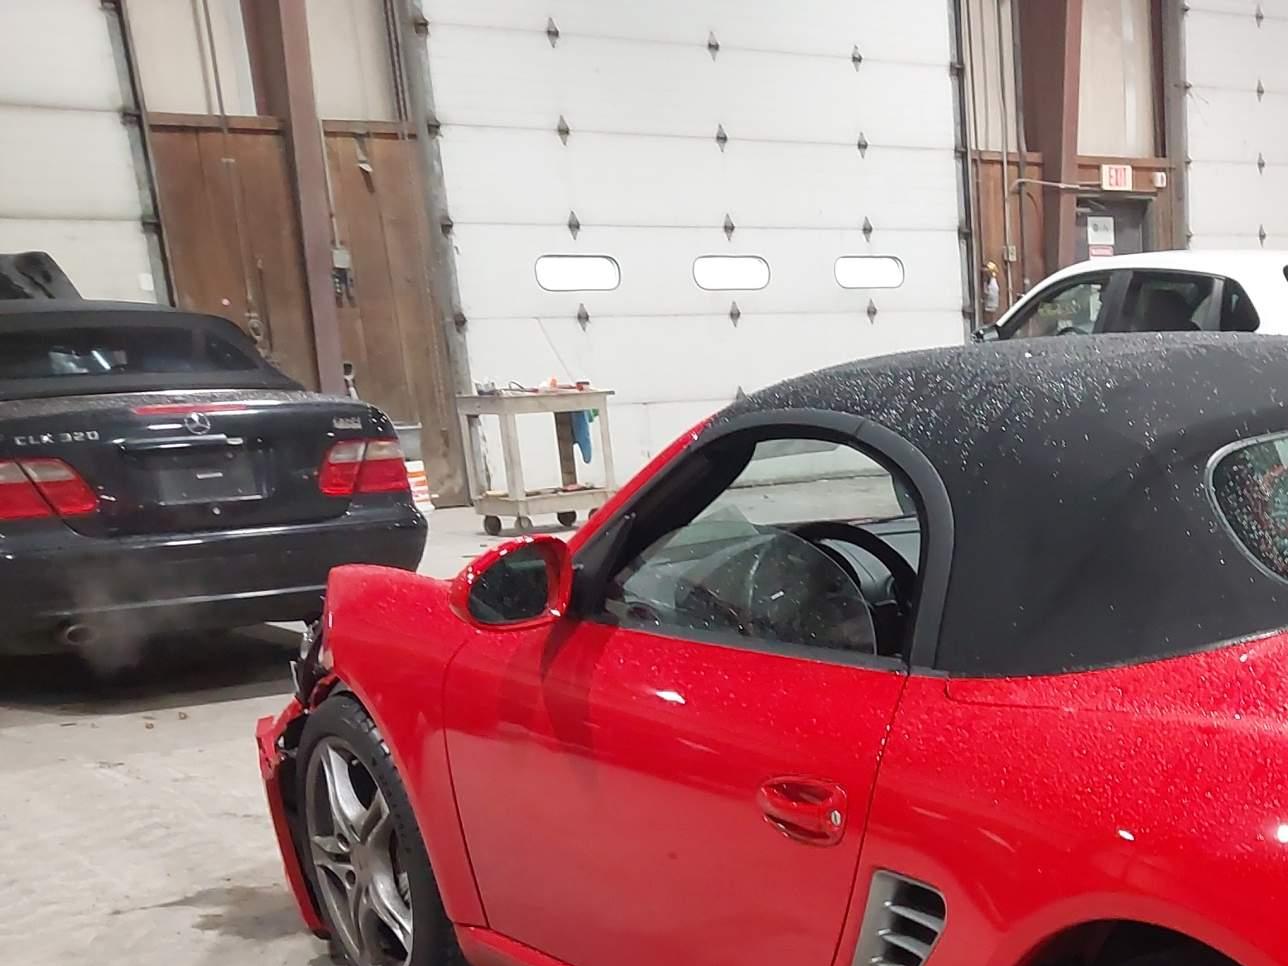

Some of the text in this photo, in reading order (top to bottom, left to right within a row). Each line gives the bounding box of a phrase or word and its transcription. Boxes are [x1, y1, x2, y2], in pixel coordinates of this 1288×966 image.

[1107, 166, 1128, 187] EXIT
[14, 431, 99, 446] CLK 320
